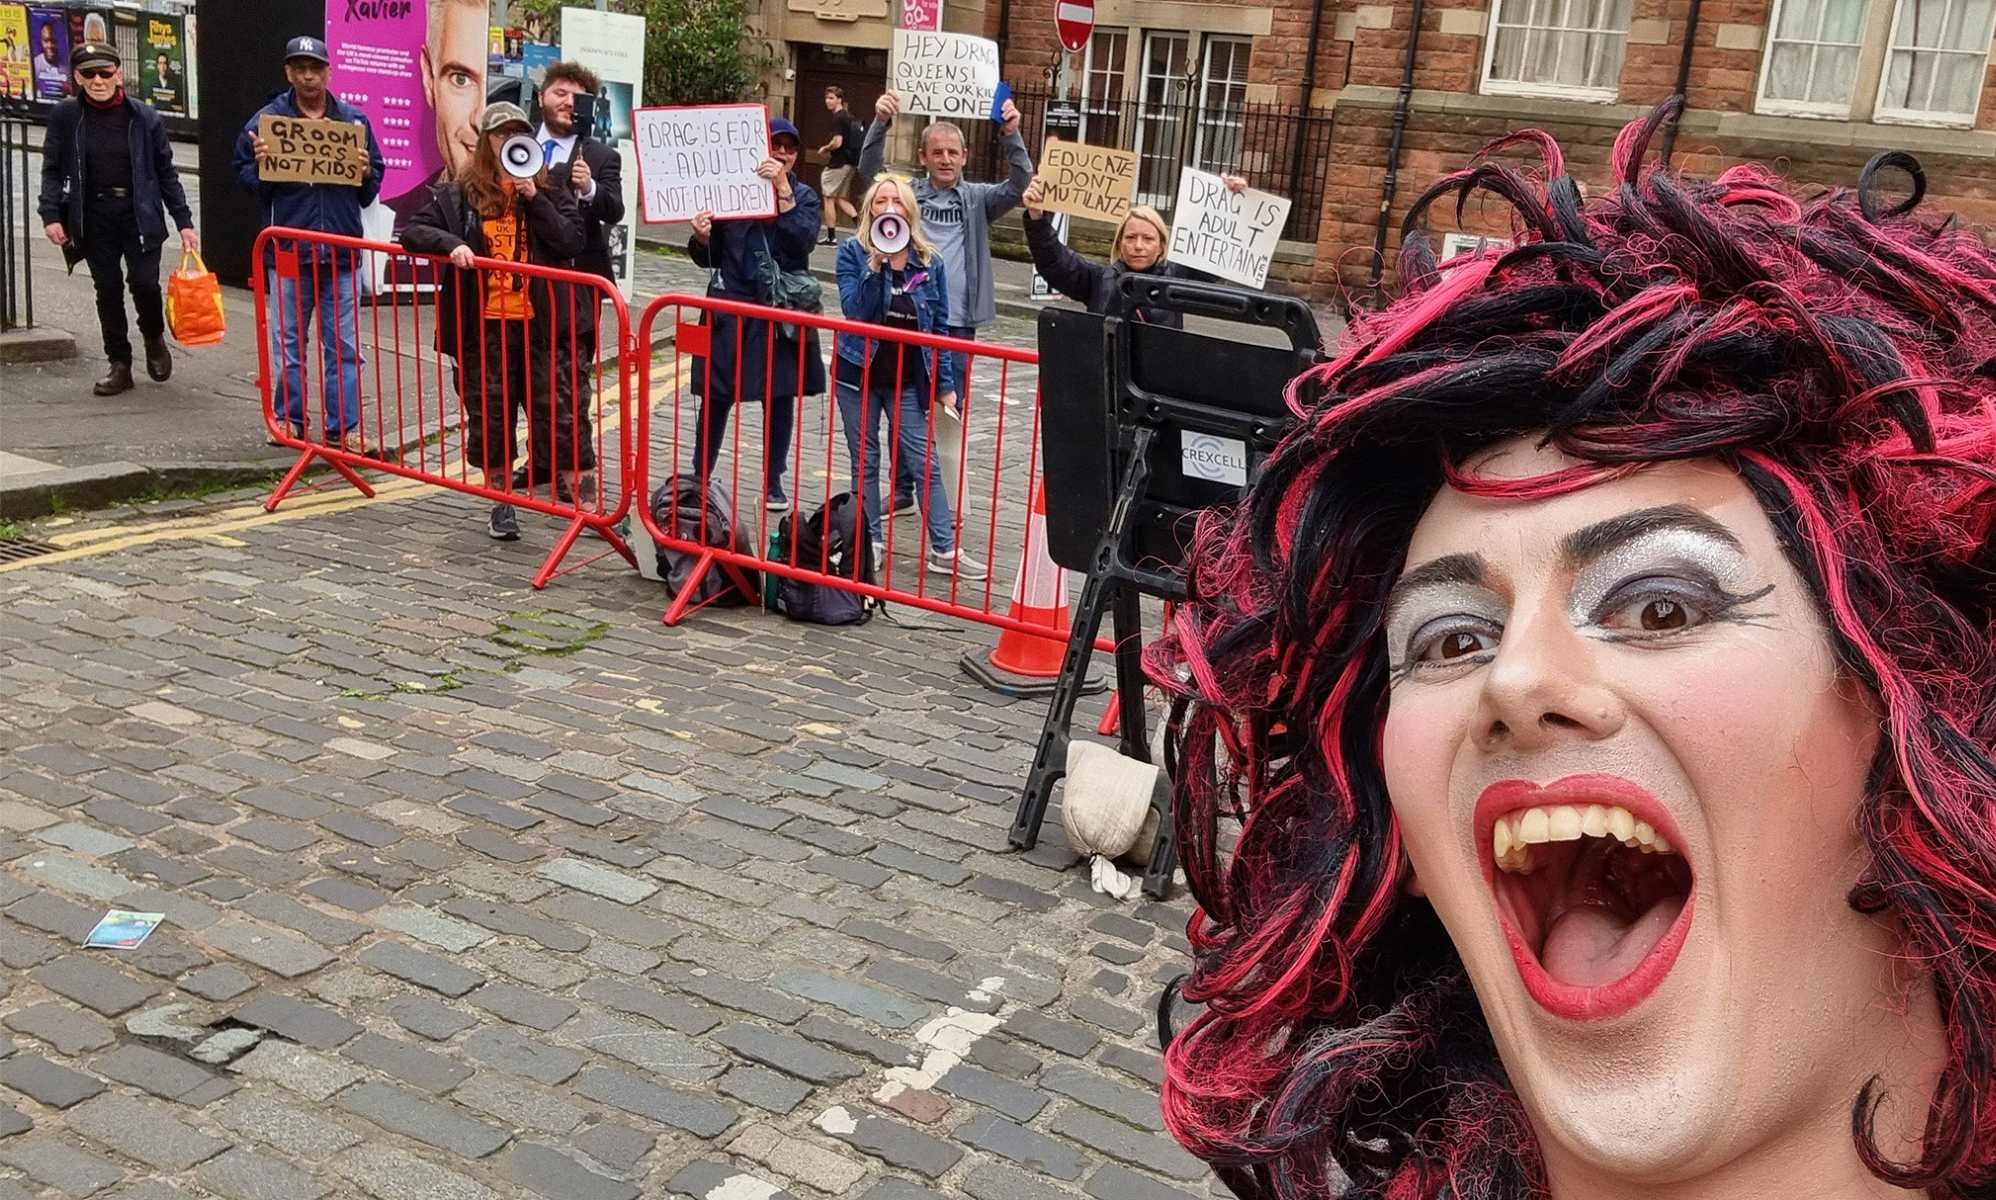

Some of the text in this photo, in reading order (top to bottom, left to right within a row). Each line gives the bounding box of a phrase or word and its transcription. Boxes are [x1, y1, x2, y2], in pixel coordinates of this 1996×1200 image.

[345, 0, 411, 22] Xavier
[904, 34, 947, 59] HEY
[896, 78, 940, 94] LEAVE
[945, 83, 973, 95] OUR
[897, 61, 976, 84] QUEENS!
[909, 94, 992, 117] ALONE
[270, 120, 358, 148] GROOM
[648, 119, 765, 148] DRAG IS FOR
[280, 138, 348, 160] DOGS
[676, 147, 760, 179] ADULTS
[265, 157, 357, 179] NOT KIDS
[1048, 149, 1135, 178] EDUCATE
[1060, 168, 1118, 198] DONT
[656, 183, 769, 213] NOT CHILDREN
[1041, 181, 1129, 218] MUTILATE
[1190, 176, 1281, 227] DRAG IS
[1199, 212, 1263, 248] ADULT
[1181, 447, 1246, 470] CREXCELL
